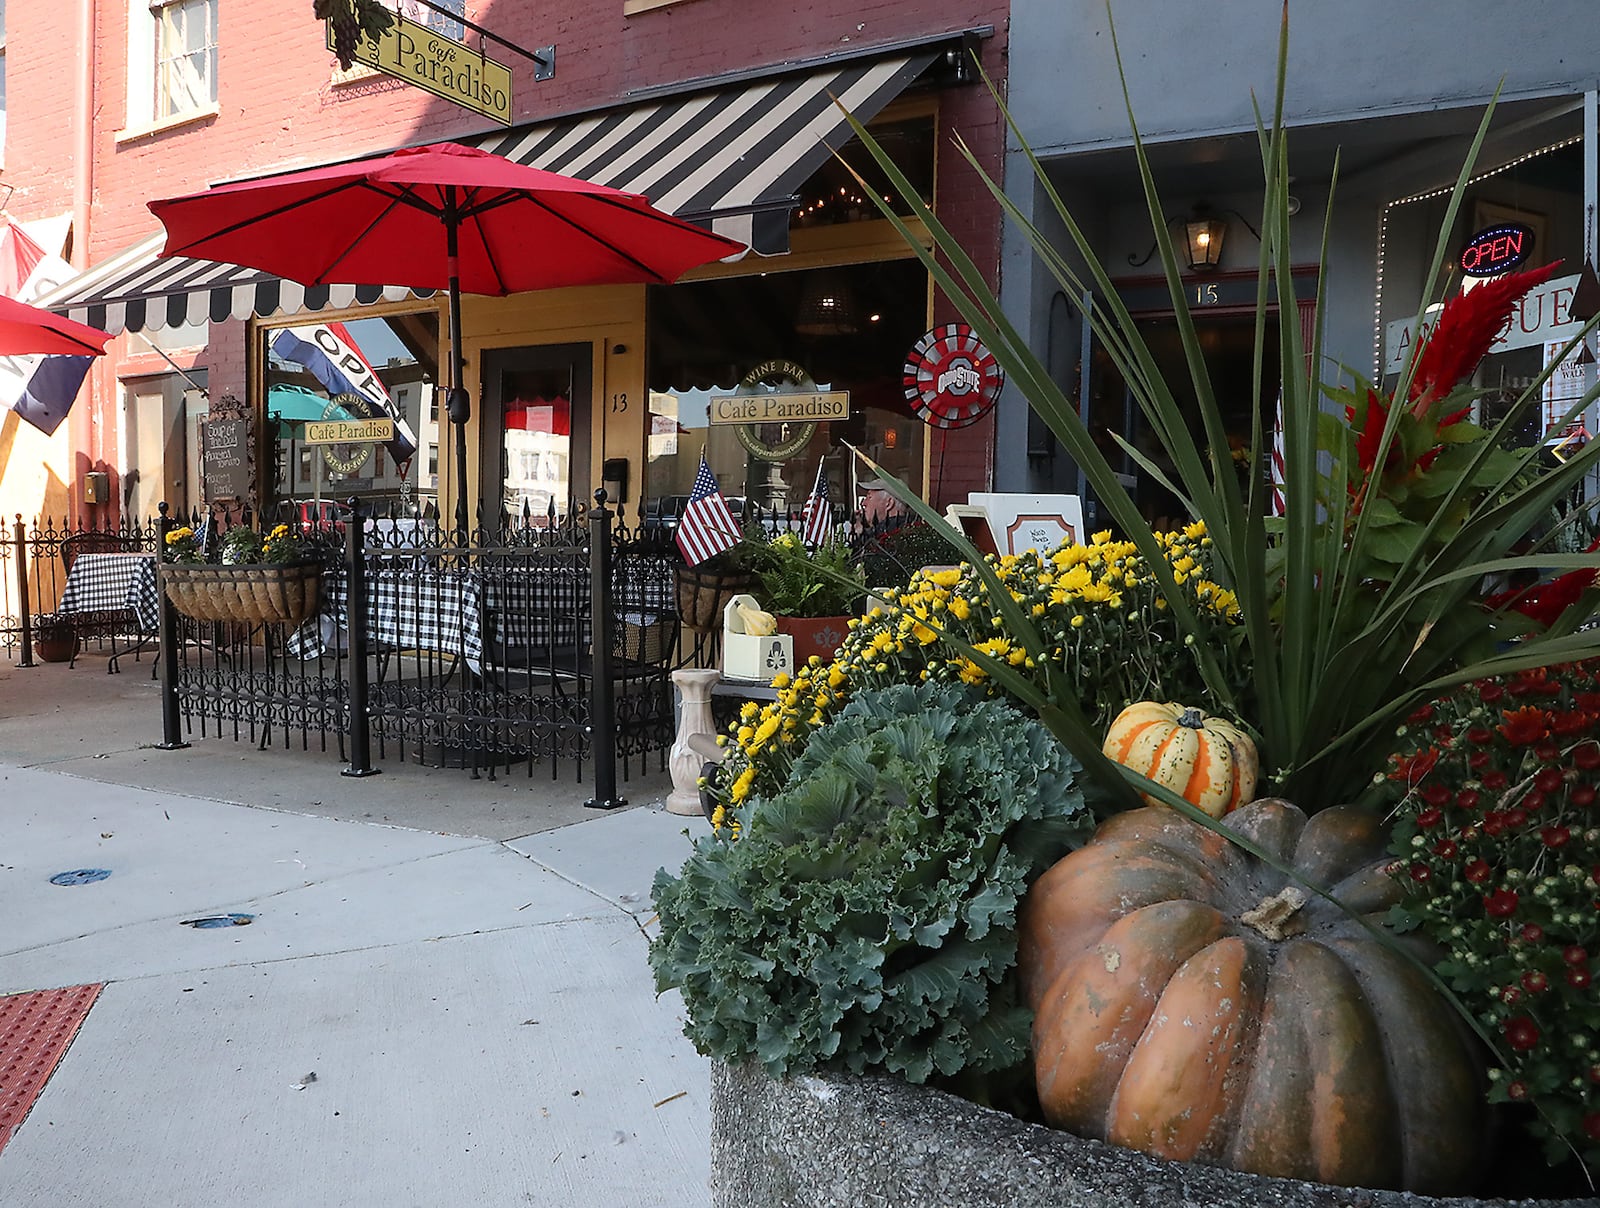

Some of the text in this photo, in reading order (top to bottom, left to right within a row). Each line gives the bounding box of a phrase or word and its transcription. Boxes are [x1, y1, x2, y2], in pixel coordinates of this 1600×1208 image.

[427, 39, 457, 62] Café
[393, 29, 507, 112] Paradiso
[1461, 231, 1524, 270] OPEN
[1197, 284, 1218, 304] 15
[314, 328, 403, 424] OPEN
[745, 361, 805, 384] WINE BAR
[612, 393, 628, 412] 13
[718, 396, 843, 419] Café Paradiso
[309, 421, 390, 440] Café Paradiso
